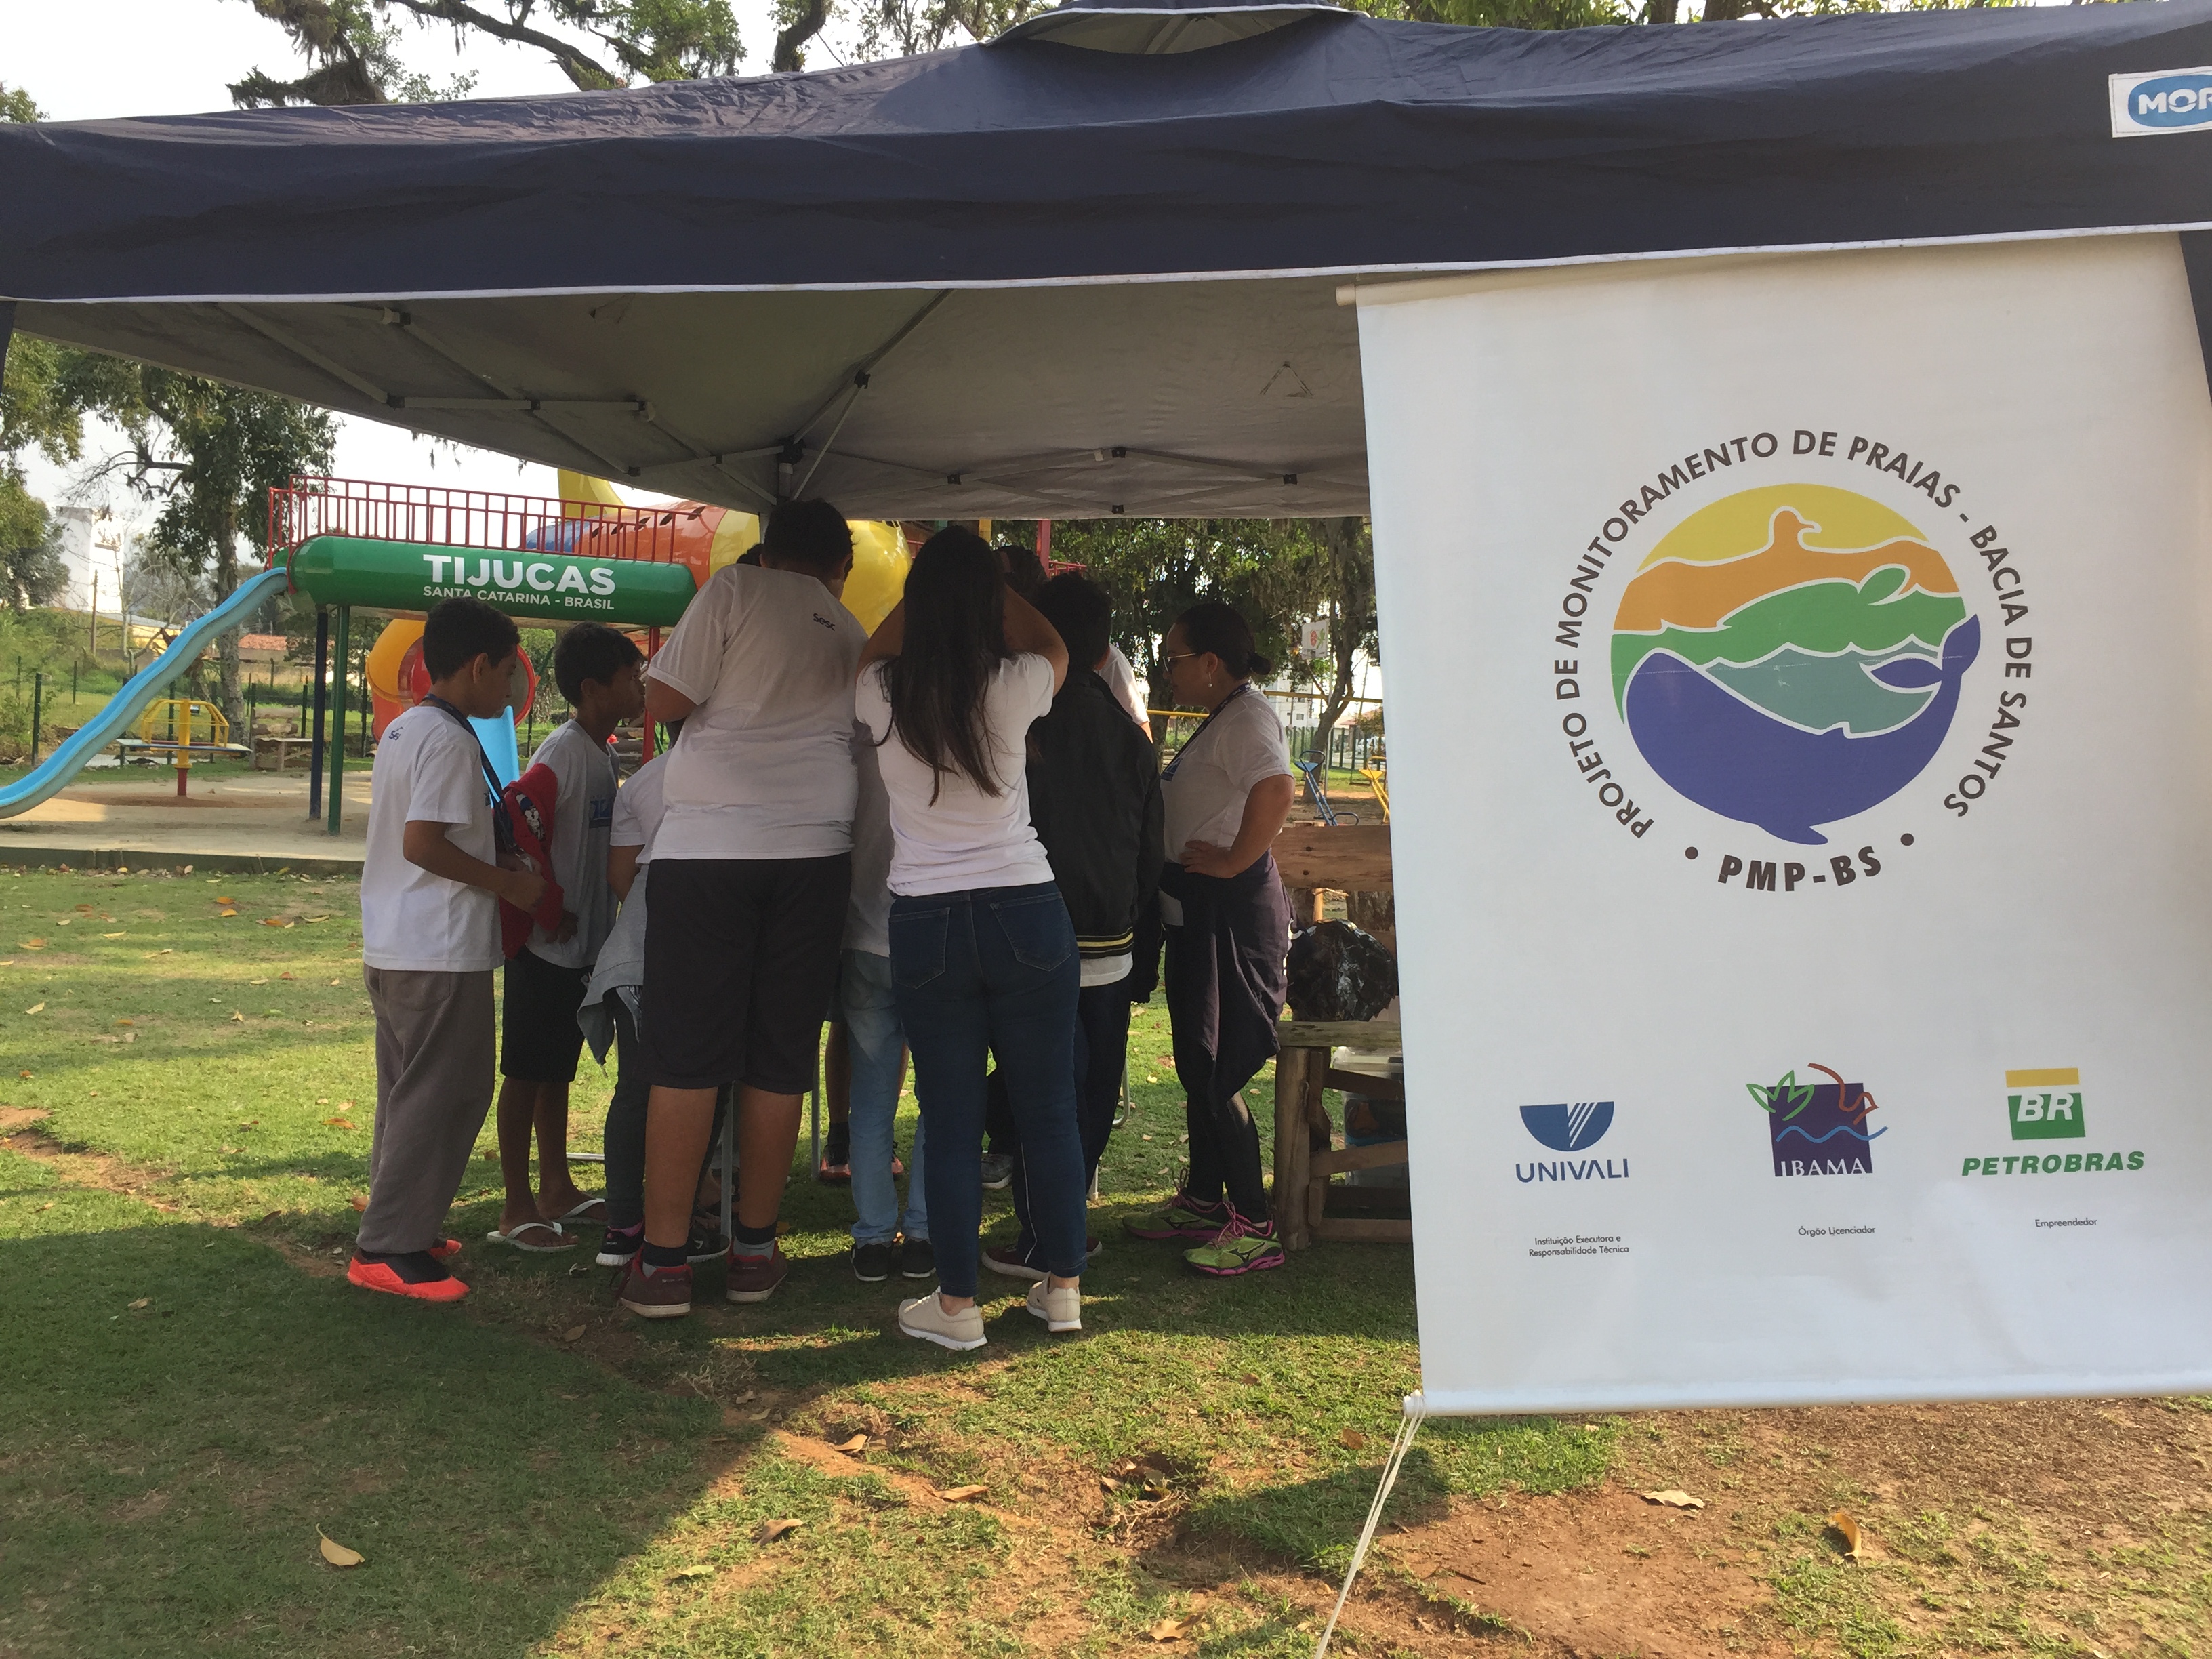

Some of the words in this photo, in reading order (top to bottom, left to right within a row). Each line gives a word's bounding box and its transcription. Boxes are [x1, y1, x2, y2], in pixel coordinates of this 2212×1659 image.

[1793, 430, 1838, 457] DE
[1847, 436, 1961, 508] PRAIAS
[1555, 432, 1778, 649] MONITORAMENTO
[423, 554, 615, 595] TIJUCAS
[1969, 525, 2029, 626] BACIA
[423, 586, 472, 598] SANTA
[477, 590, 550, 605] CATARINA
[565, 596, 615, 610] BRASIL
[2005, 637, 2032, 678] DE
[1554, 659, 1580, 700] DE
[1944, 690, 2027, 817] SANTOS
[1562, 712, 1654, 839] PROJETO
[1717, 846, 1882, 892] PMP-BS
[2017, 1093, 2074, 1122] BR
[1515, 1158, 1629, 1183] UNIVALI
[1780, 1158, 1866, 1176] IBAMA
[1962, 1151, 2144, 1176] PETROBRAS
[1798, 1225, 1826, 1237] Órgão
[1828, 1225, 1876, 1236] Licenciador
[2035, 1217, 2097, 1229] Empreendedor
[1529, 1246, 1597, 1258] Responsabilidade
[1599, 1245, 1629, 1254] Técnica
[1534, 1236, 1574, 1246] Instituição
[1576, 1235, 1614, 1244] Executora
